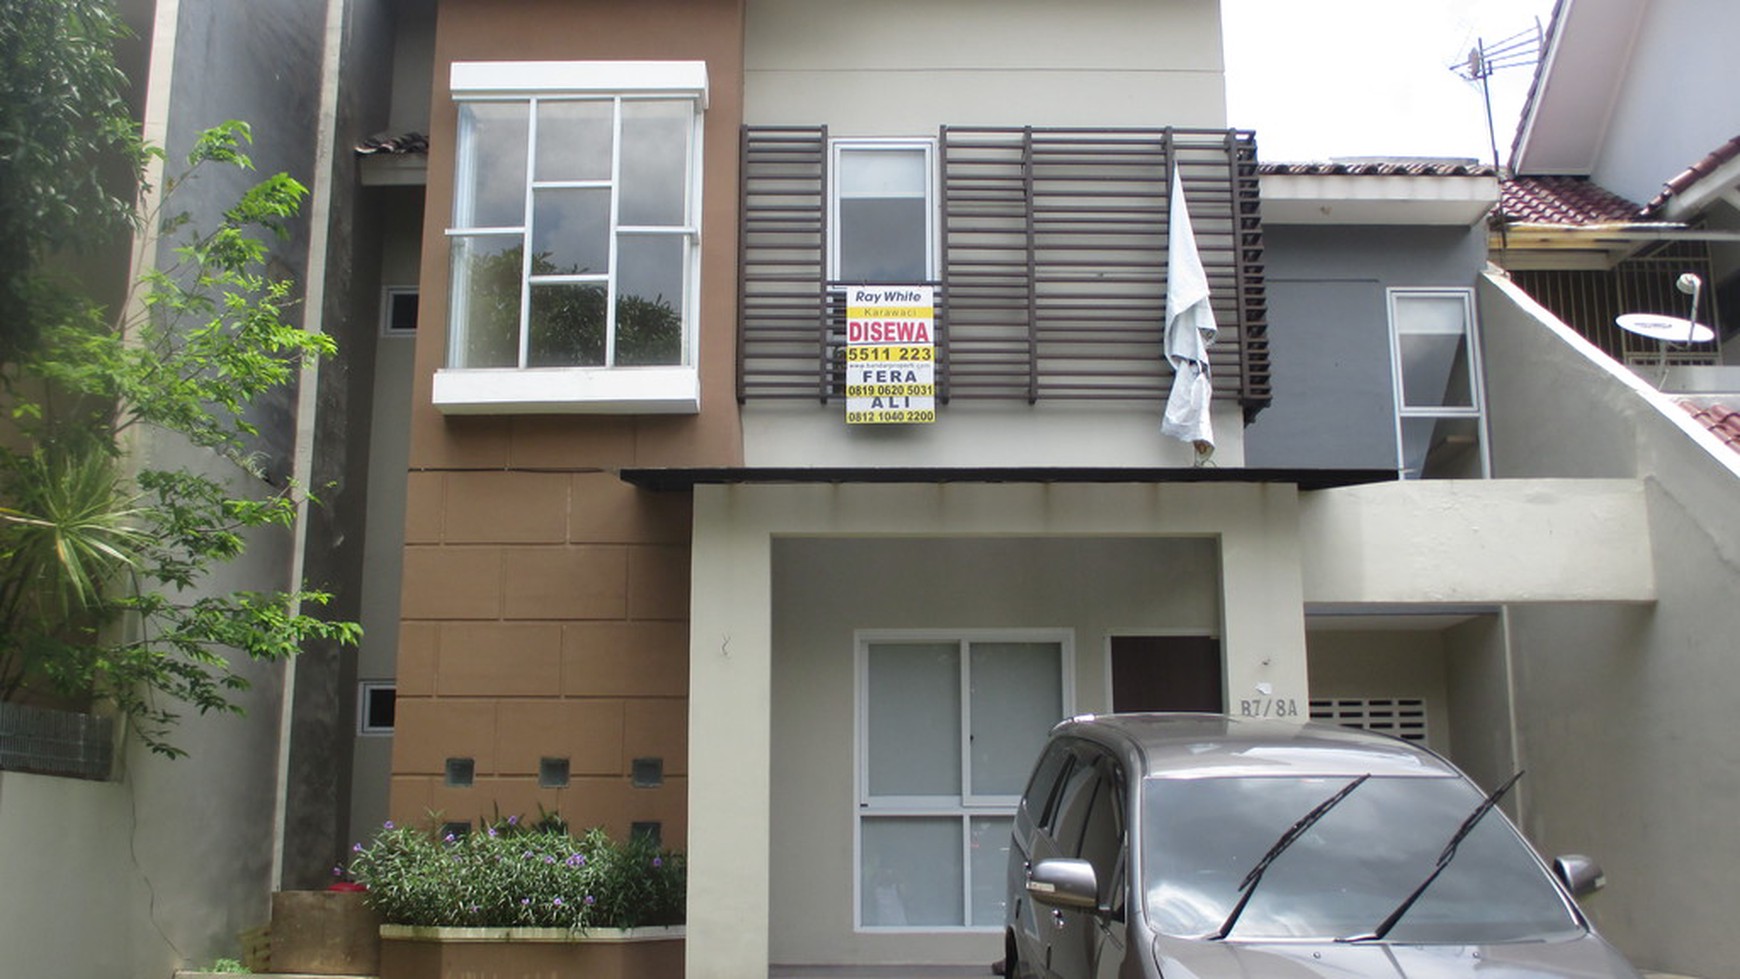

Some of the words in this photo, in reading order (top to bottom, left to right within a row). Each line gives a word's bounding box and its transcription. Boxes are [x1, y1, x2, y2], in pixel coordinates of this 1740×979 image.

[855, 291, 881, 303] Ray
[884, 291, 922, 302] White
[864, 308, 917, 317] Karawaci
[849, 322, 929, 342] DISEWA
[849, 348, 890, 361] 5511
[899, 348, 931, 361] 223
[863, 370, 917, 382] FERA
[848, 385, 875, 396] 0819
[878, 385, 904, 396] 0620
[907, 385, 932, 395] 5031
[871, 396, 910, 408] ALI
[848, 412, 874, 422] 0812
[907, 411, 934, 421] 2200
